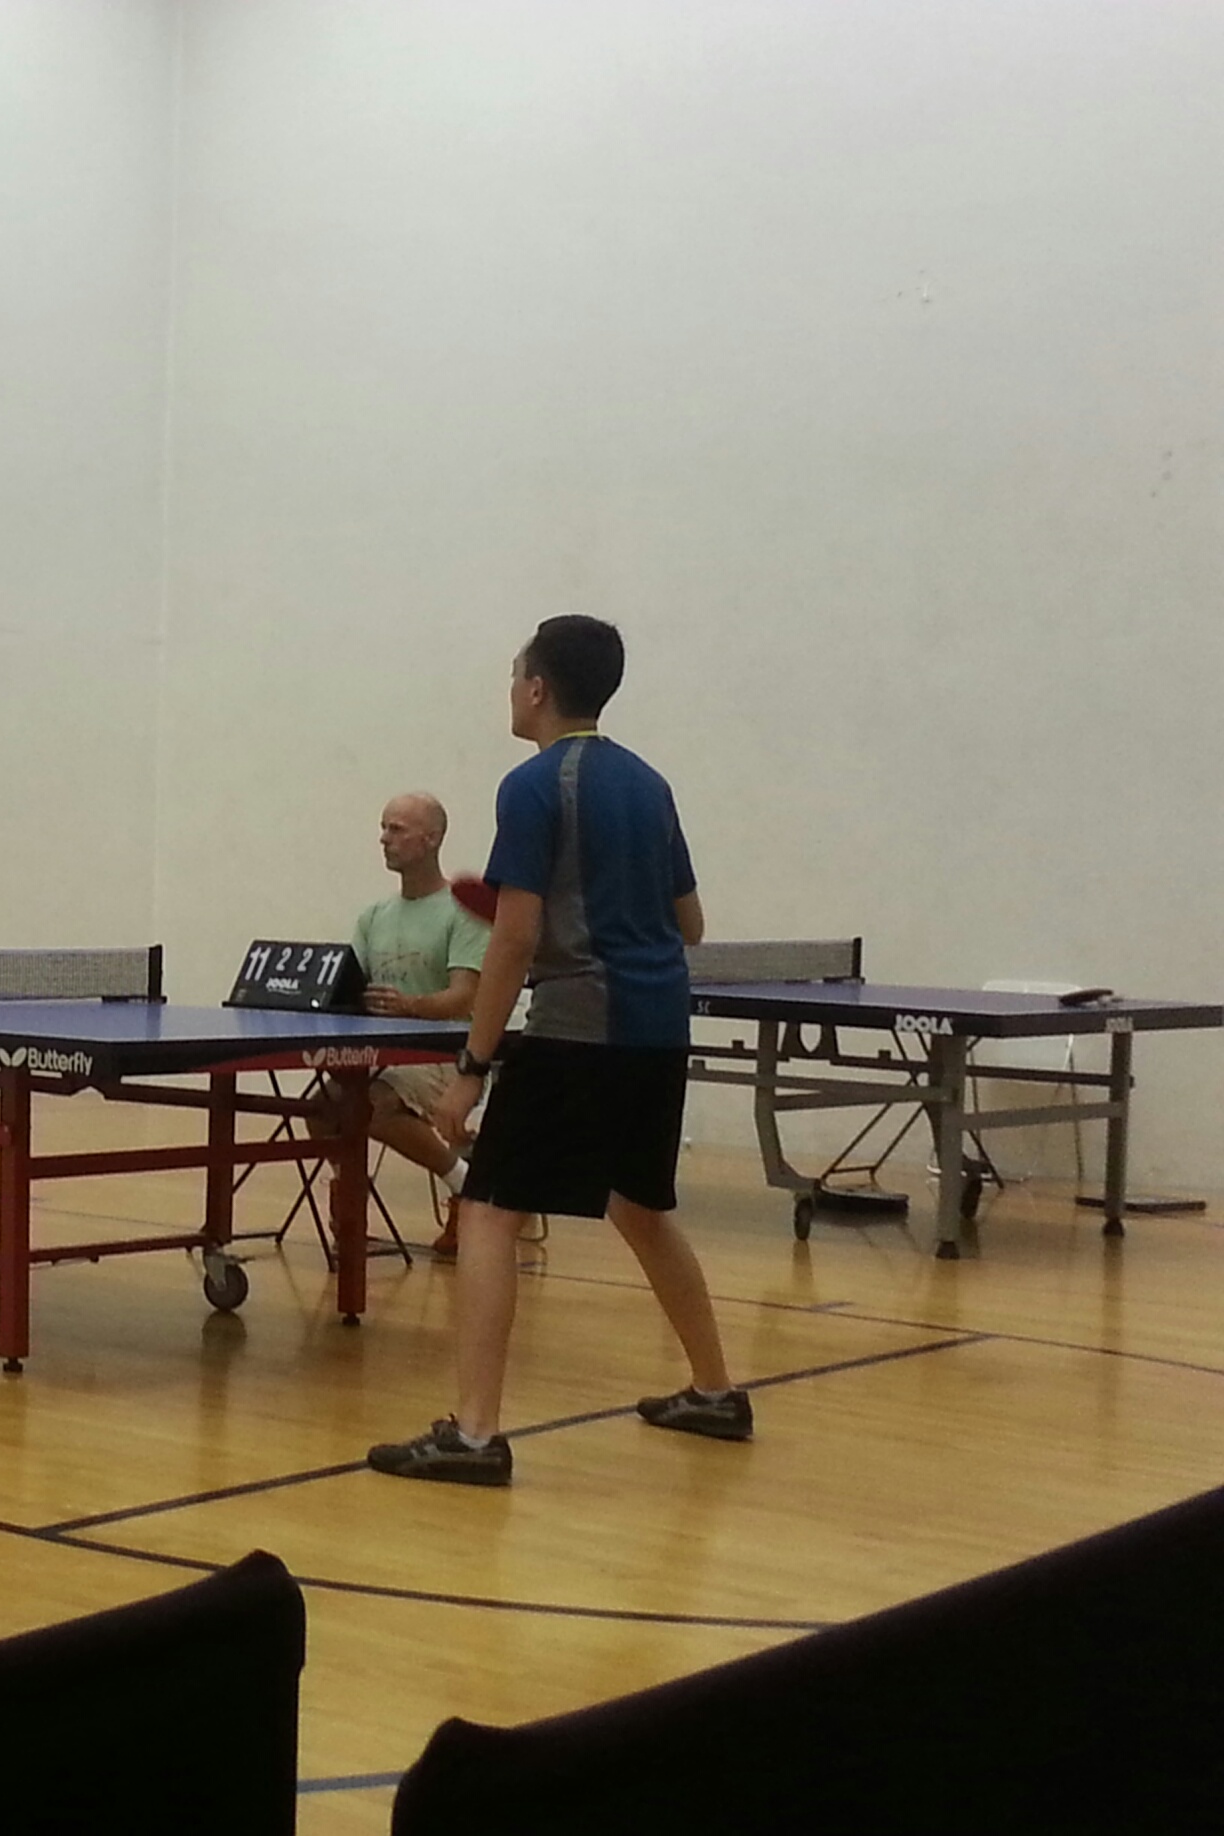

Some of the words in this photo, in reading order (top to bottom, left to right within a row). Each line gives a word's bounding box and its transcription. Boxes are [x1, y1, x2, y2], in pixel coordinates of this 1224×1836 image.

[244, 946, 272, 981] 11
[275, 946, 293, 972] 2
[296, 947, 314, 972] 2
[316, 950, 345, 986] 11
[894, 1013, 954, 1036] JOOLA
[27, 1046, 93, 1077] Butterfly
[326, 1044, 380, 1067] Butterfly
